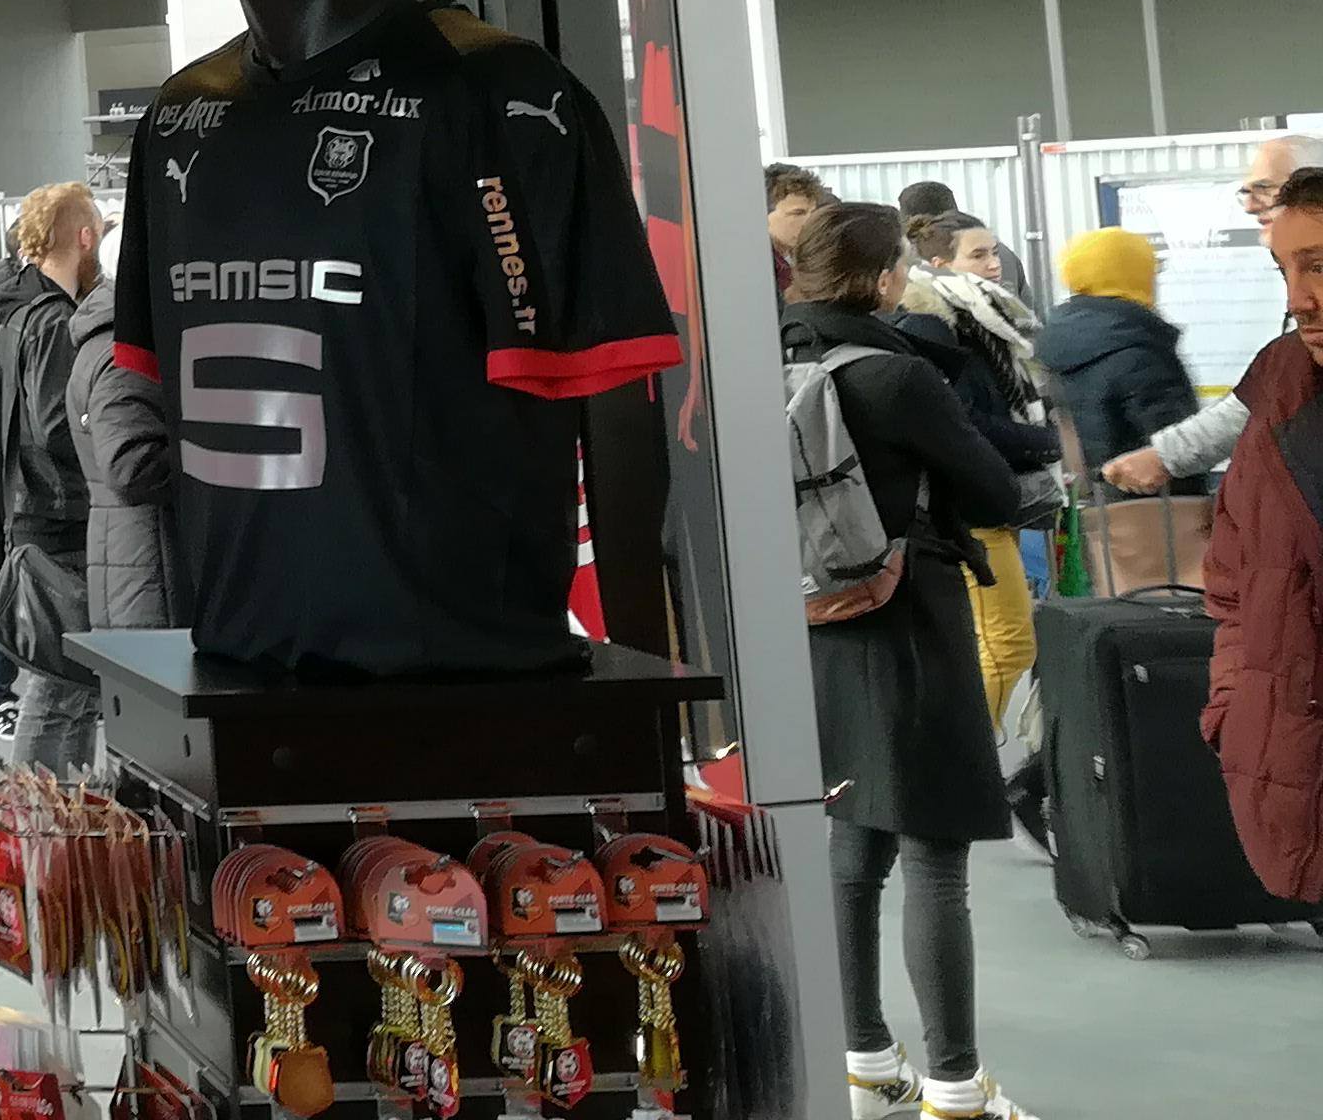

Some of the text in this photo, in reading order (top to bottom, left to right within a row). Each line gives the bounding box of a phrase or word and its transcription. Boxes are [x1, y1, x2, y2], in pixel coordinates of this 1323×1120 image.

[170, 259, 363, 304] SAMSIC
[476, 176, 536, 336] rennes.fr
[180, 322, 327, 490] S
